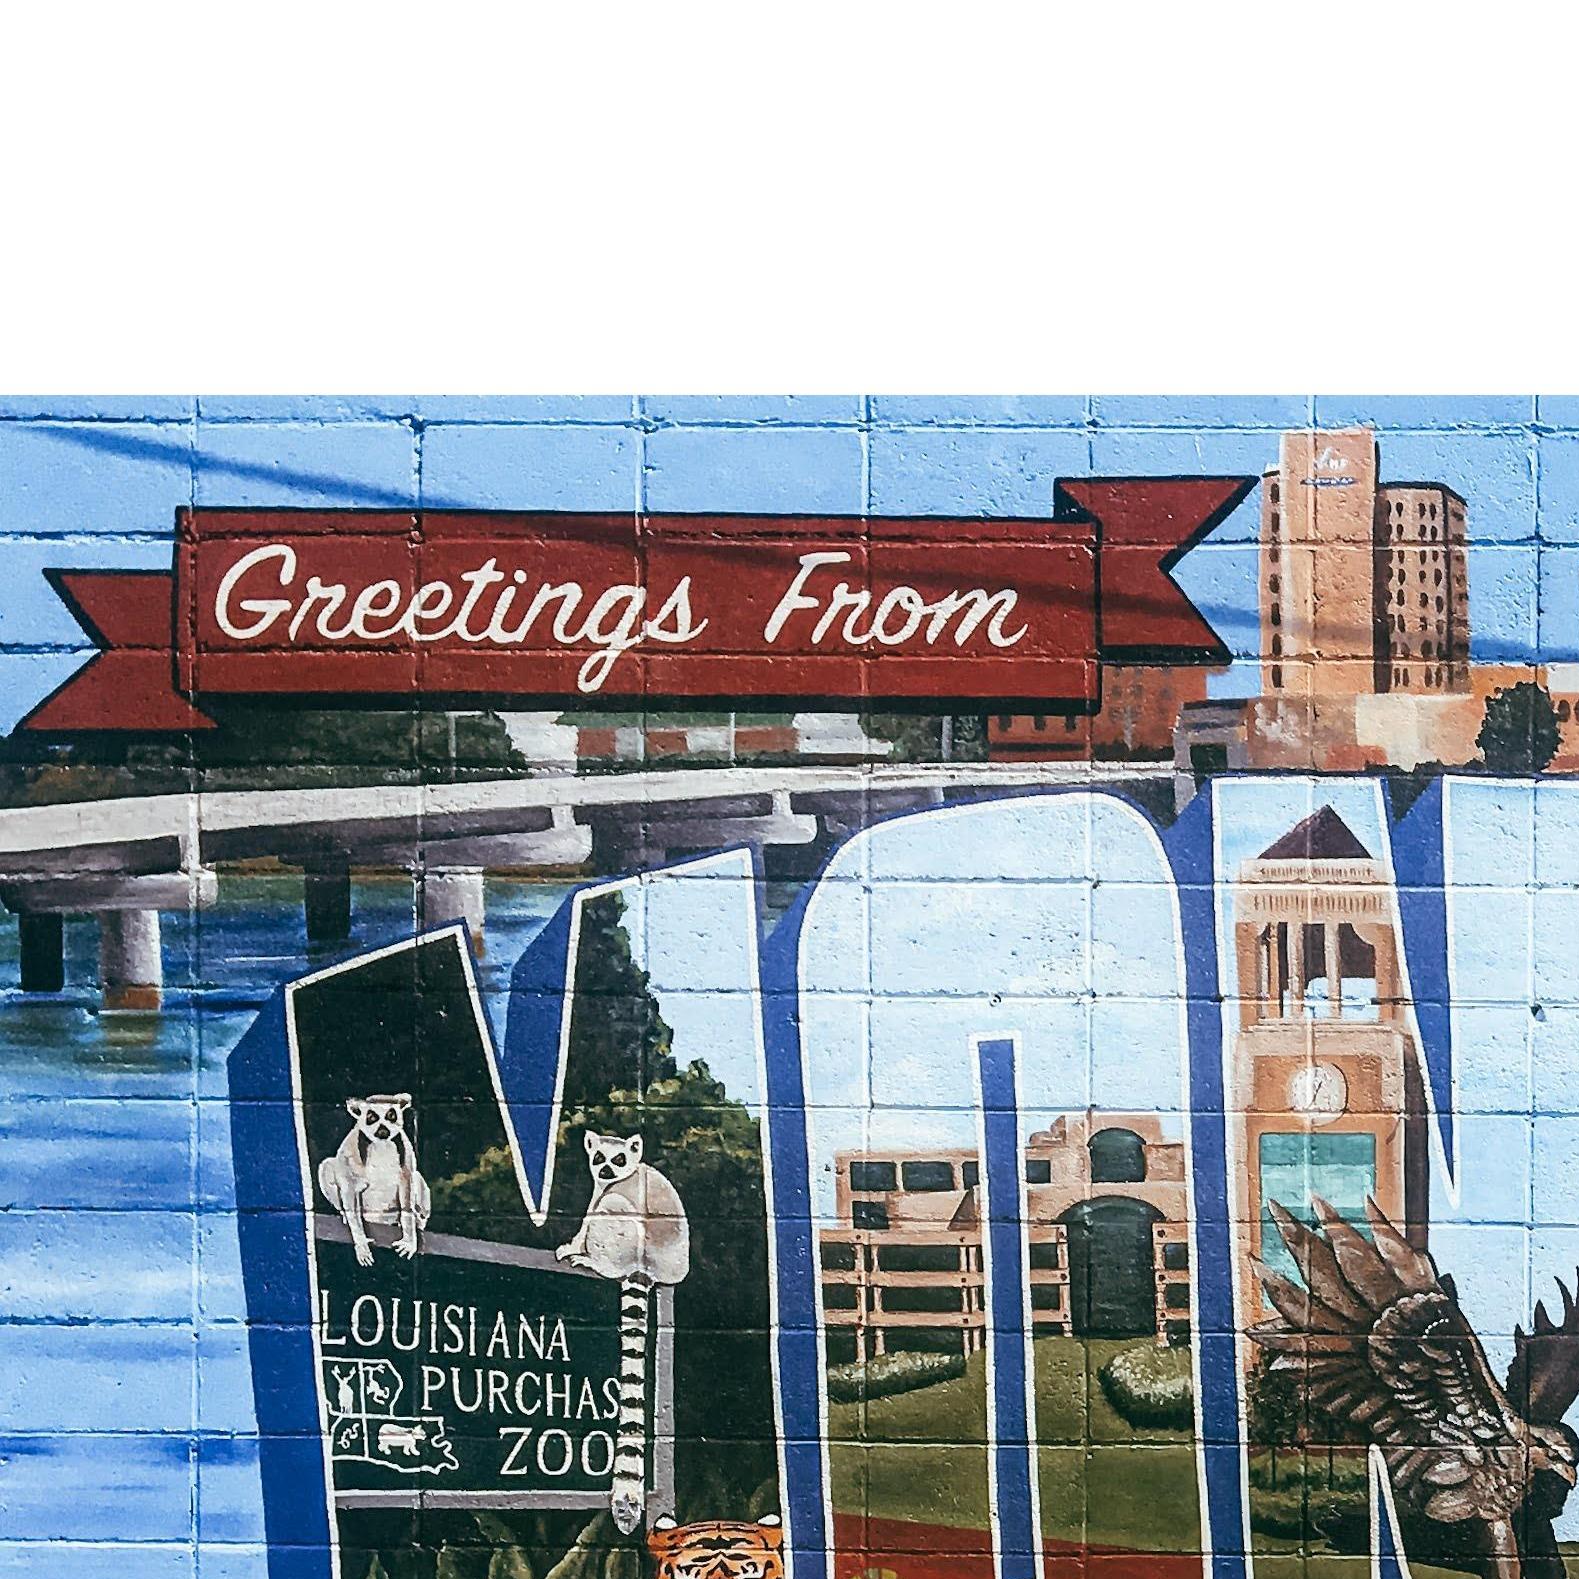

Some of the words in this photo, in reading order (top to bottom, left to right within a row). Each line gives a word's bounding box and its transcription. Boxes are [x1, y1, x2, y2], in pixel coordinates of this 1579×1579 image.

[215, 543, 708, 693] Greetings
[764, 551, 1028, 649] From
[319, 1289, 571, 1362] LOUISIANA
[499, 1427, 615, 1477] ZOO
